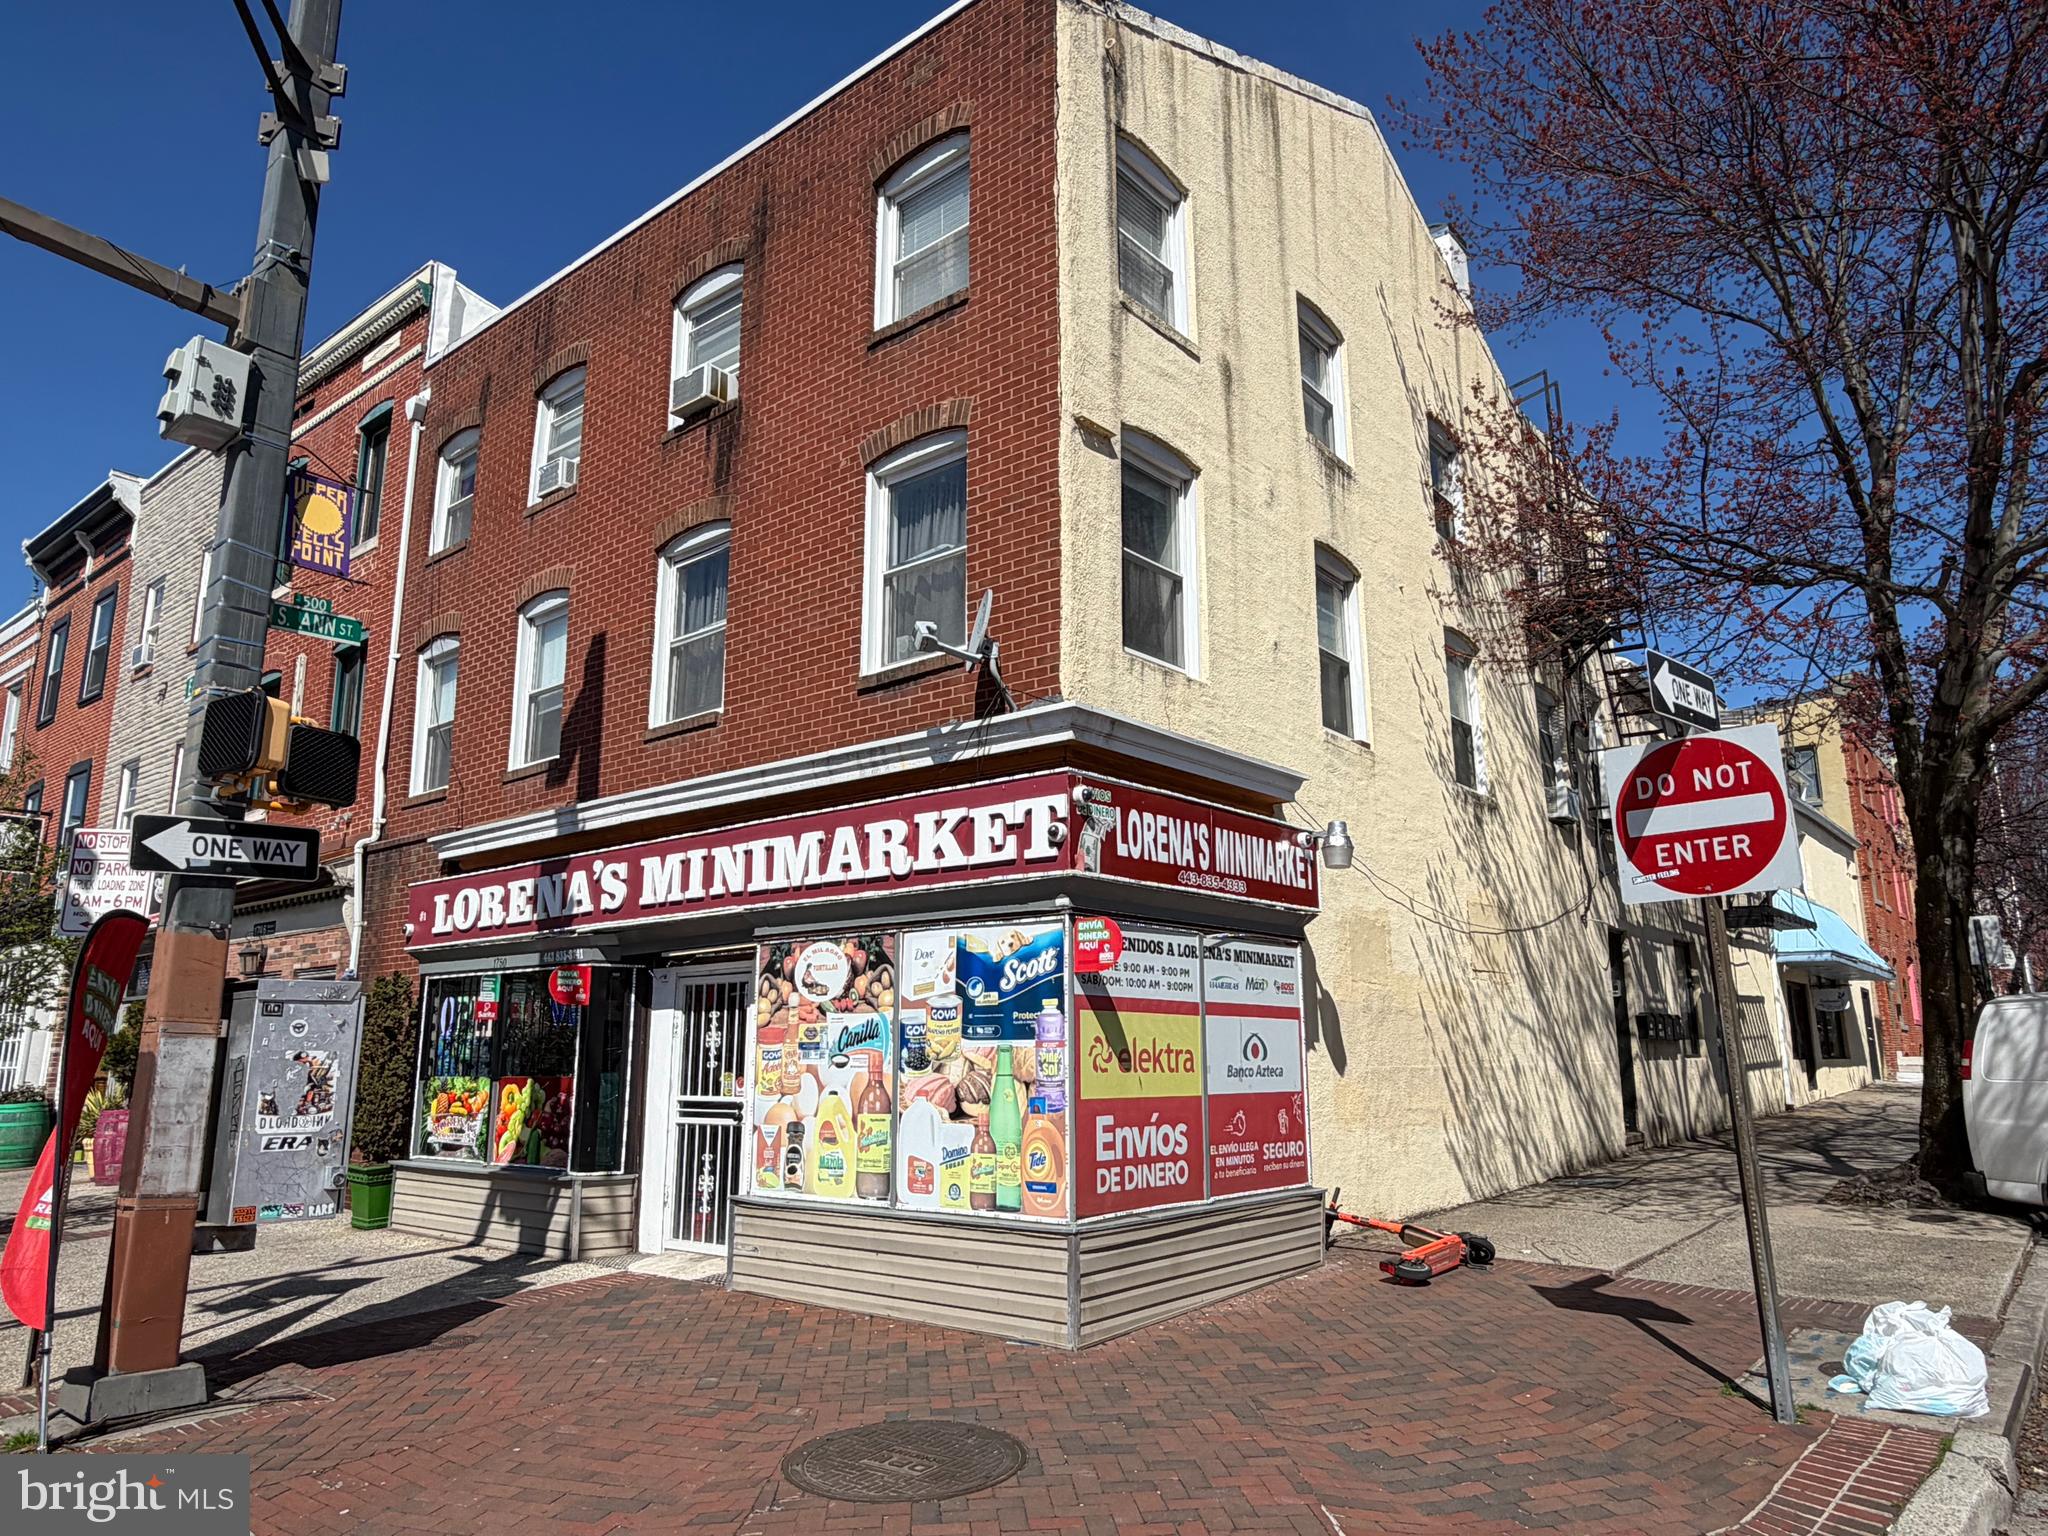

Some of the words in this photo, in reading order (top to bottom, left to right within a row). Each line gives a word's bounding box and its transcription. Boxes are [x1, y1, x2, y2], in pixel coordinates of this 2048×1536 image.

[293, 475, 347, 514] UPPER
[303, 596, 327, 612] 500
[300, 612, 337, 637] ANN
[1671, 678, 1691, 706] ONE
[1692, 688, 1712, 715] WAY
[1636, 773, 1675, 800] DO
[1692, 760, 1753, 792] NOT
[77, 834, 96, 848] NO
[99, 835, 130, 849] STOP
[192, 835, 243, 859] ONE
[252, 840, 301, 863] WAY
[1115, 805, 1210, 871] LORENA'S
[1215, 827, 1314, 890] MINIMARKET
[1655, 834, 1752, 868] ENTER
[73, 861, 92, 875] NO
[432, 858, 628, 934] LORENA'S
[638, 793, 1068, 905] MINIMARKET
[73, 879, 95, 891] TRUCK
[98, 880, 125, 891] LOADING
[128, 880, 146, 891] ZONE
[1177, 870, 1247, 893] 443-835-4333
[1078, 919, 1103, 930] ENVÍA
[1078, 930, 1109, 941] DINERO
[1078, 940, 1098, 951] AQUÍ
[802, 953, 811, 962] EL
[811, 947, 843, 961] MILAGRO
[914, 948, 935, 961] Dove
[1167, 941, 1175, 956] A
[1177, 943, 1232, 962] LORENA'S
[1233, 949, 1295, 968] MINIMARKET
[1000, 948, 1058, 992] Scott
[1123, 962, 1141, 974] 9:00
[1143, 964, 1155, 974] AM
[1162, 965, 1178, 976] 9:00
[1179, 967, 1190, 978] PM
[1125, 977, 1147, 988] 10:00
[1148, 979, 1161, 989] AM
[931, 1008, 957, 1020] GOYA
[838, 1018, 881, 1052] Canilla
[906, 1025, 926, 1036] GOY
[1118, 1037, 1195, 1073] elektra
[1227, 1064, 1254, 1078] Banco
[1255, 1064, 1284, 1078] Azteca
[263, 1135, 313, 1151] ERA
[1095, 1112, 1189, 1162] Envíos
[942, 1144, 968, 1161] Domino
[1210, 1145, 1218, 1155] EL
[1218, 1141, 1239, 1154] ENVÍO
[1240, 1141, 1259, 1152] LLEGA
[1263, 1140, 1304, 1160] SEGURO
[819, 1154, 844, 1170] Mazola
[945, 1159, 965, 1170] SUGAR
[1029, 1151, 1047, 1170] Tide
[1215, 1157, 1225, 1167] EN
[1226, 1154, 1255, 1166] MINUTOS
[1097, 1167, 1121, 1194] DE
[1124, 1160, 1189, 1192] DINERO
[308, 1203, 335, 1217] RARE
